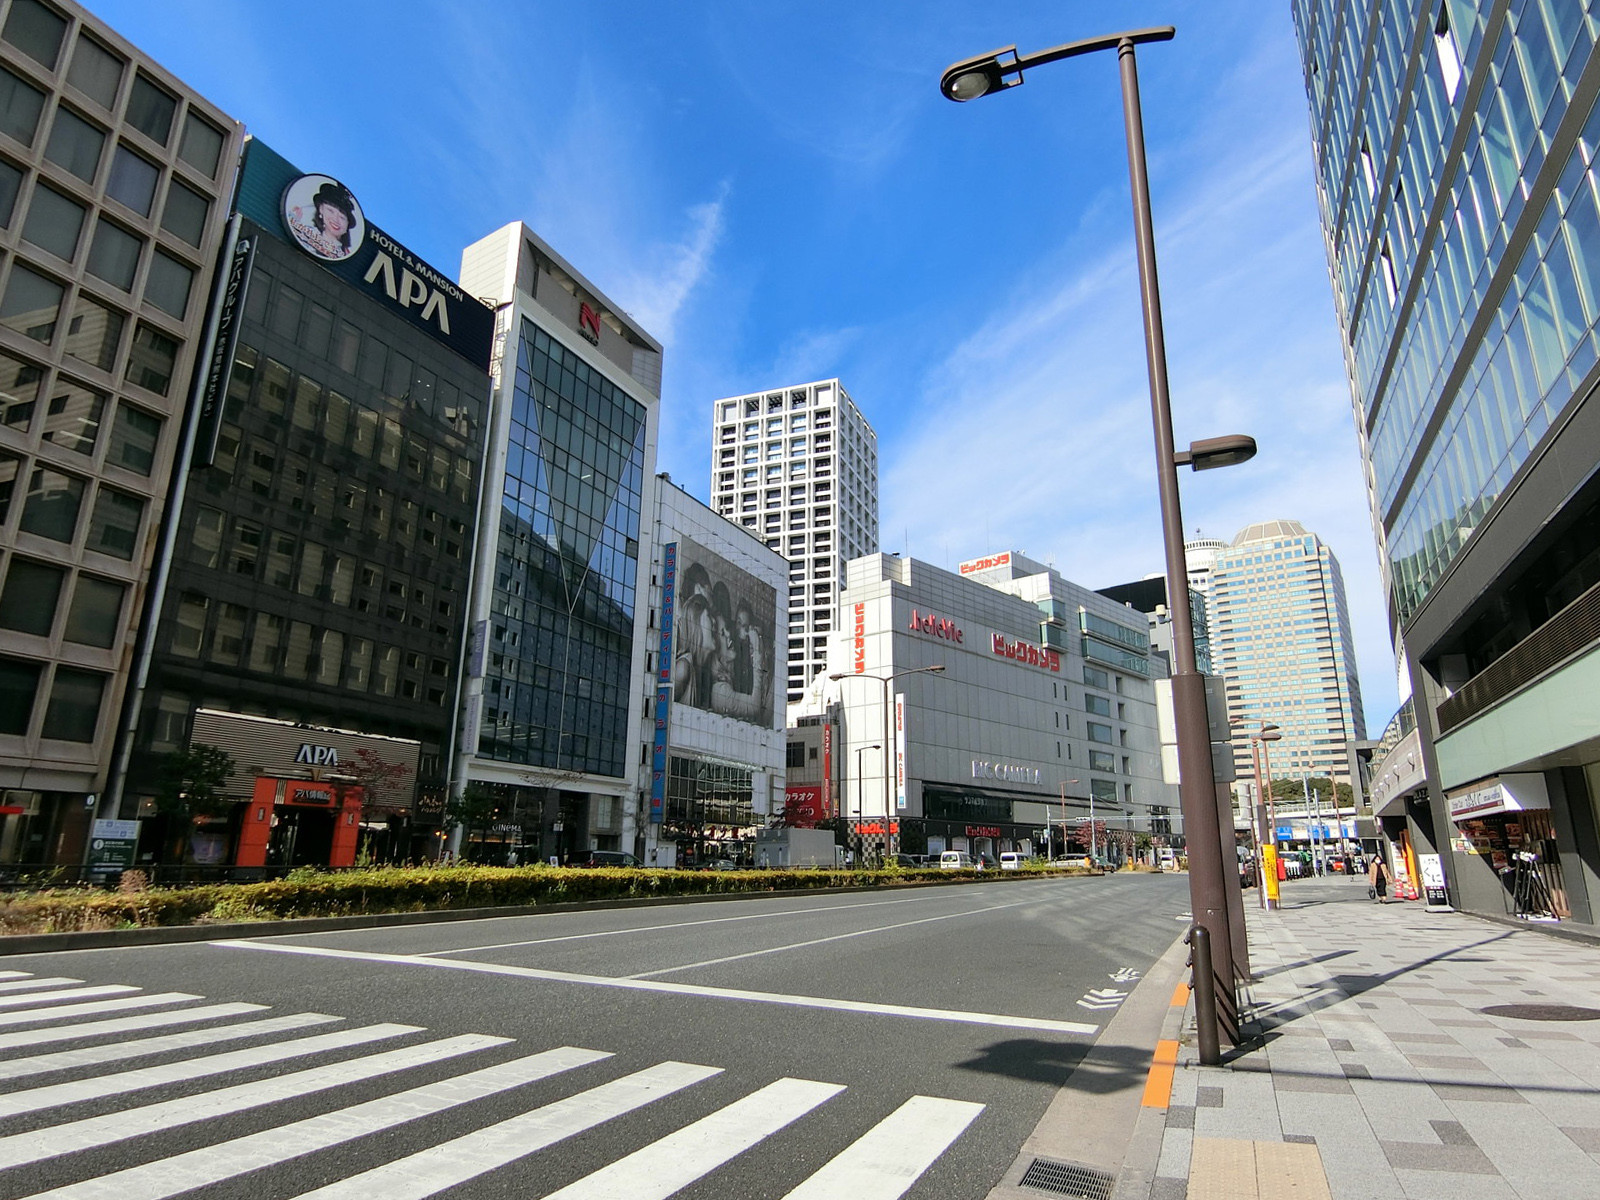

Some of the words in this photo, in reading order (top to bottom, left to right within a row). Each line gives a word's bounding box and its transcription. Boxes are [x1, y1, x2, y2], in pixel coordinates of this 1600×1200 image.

[222, 256, 244, 330] アパグループ
[364, 250, 450, 335] APA
[370, 229, 404, 261] HOTEL
[406, 255, 414, 267] &
[416, 264, 464, 302] MANSION
[961, 553, 1009, 574] ビックカメラ
[855, 602, 865, 674] ビックカメラ
[991, 632, 1060, 672] ビックカメラ
[297, 743, 338, 766] APA
[785, 792, 815, 801] カラオケ
